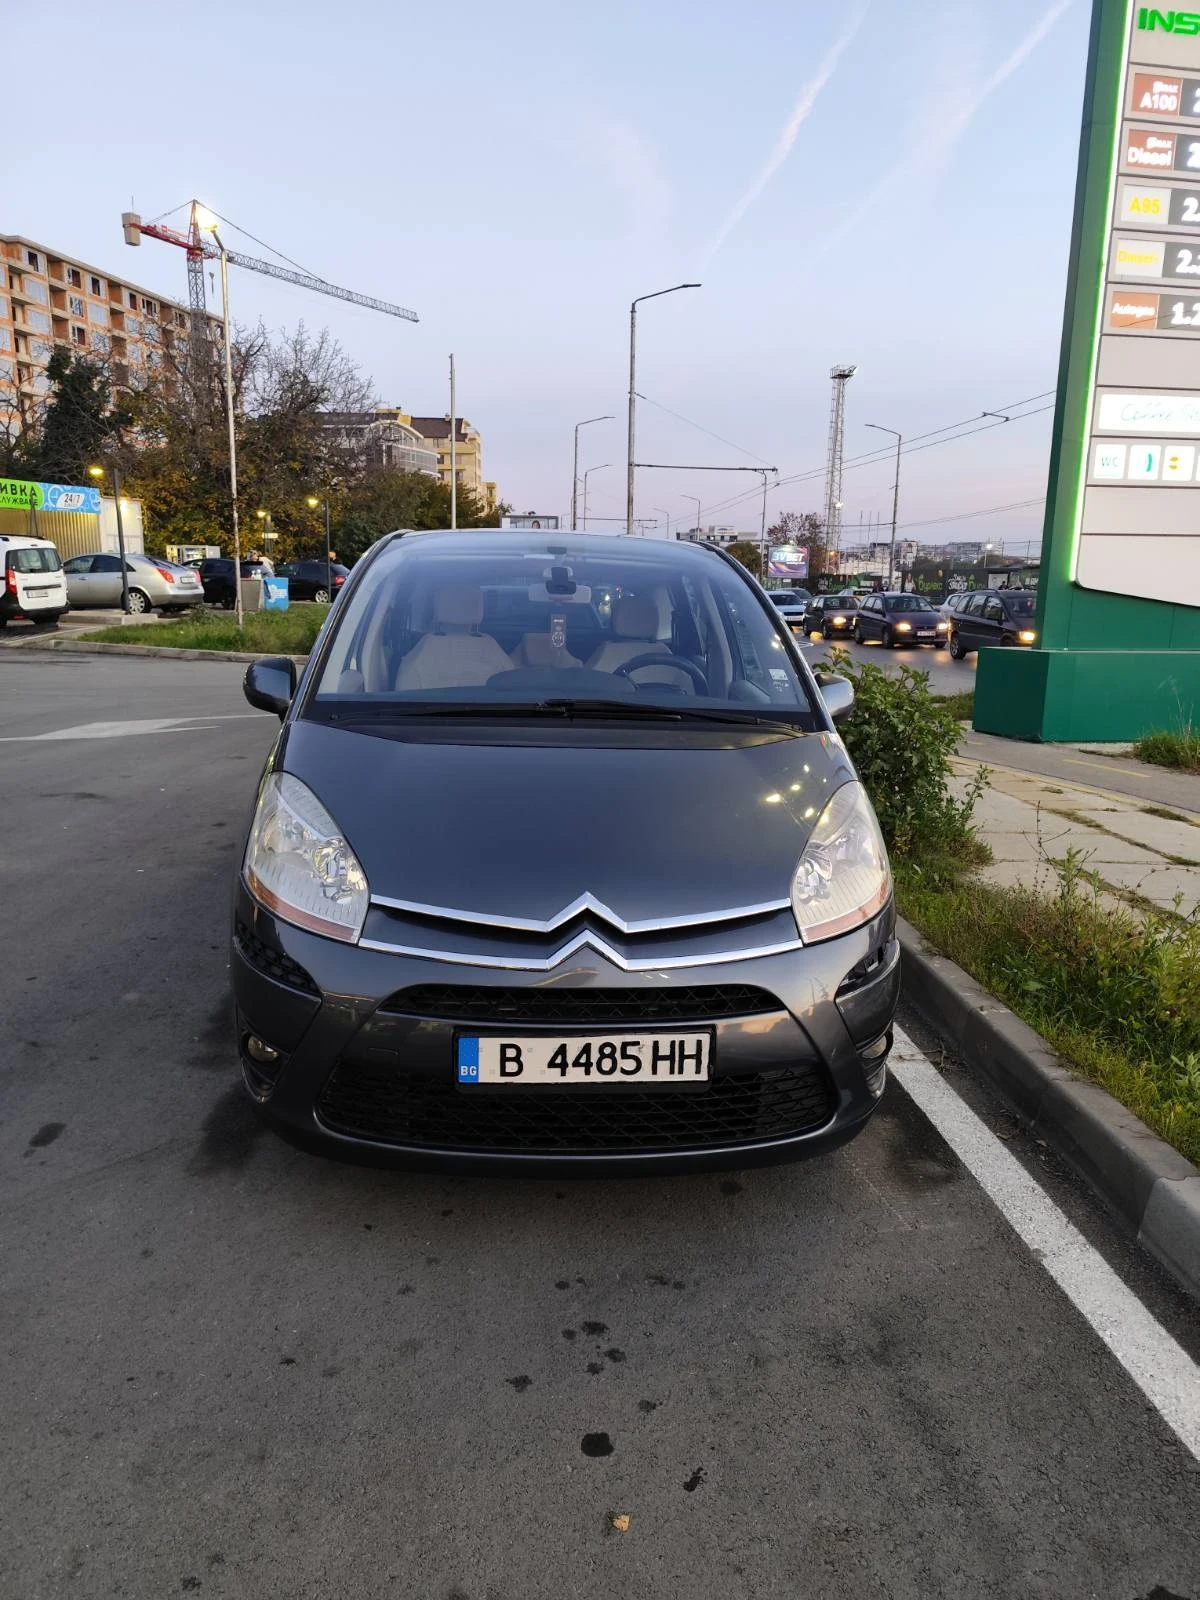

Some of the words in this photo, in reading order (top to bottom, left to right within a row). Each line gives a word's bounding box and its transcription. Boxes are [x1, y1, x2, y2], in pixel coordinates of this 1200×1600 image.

[1139, 92, 1178, 112] A100
[1127, 146, 1173, 166] Diesel
[1129, 195, 1162, 215] A95
[1101, 456, 1119, 468] WC
[64, 493, 81, 504] 24/7
[499, 1043, 524, 1077] B
[546, 1040, 642, 1077] 4485
[651, 1039, 703, 1076] HH
[460, 1065, 477, 1077] BG
